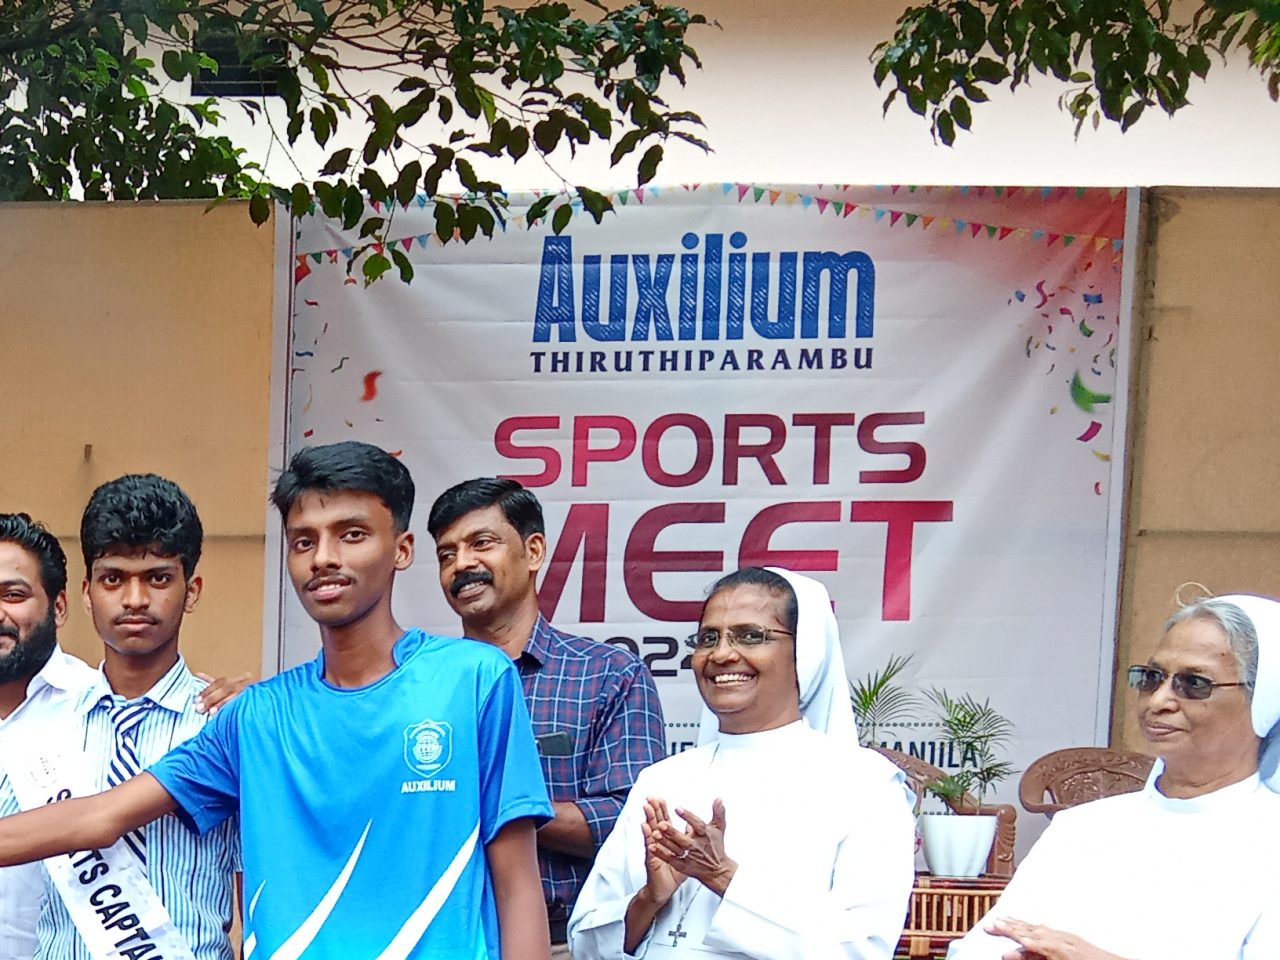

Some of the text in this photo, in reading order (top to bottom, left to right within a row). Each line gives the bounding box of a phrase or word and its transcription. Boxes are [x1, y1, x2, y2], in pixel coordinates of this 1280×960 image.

[533, 231, 876, 343] Auxilium
[530, 347, 874, 373] THIRUTHIPARAMBU
[493, 411, 927, 488] SPORTS
[400, 779, 457, 794] AUXILIUM
